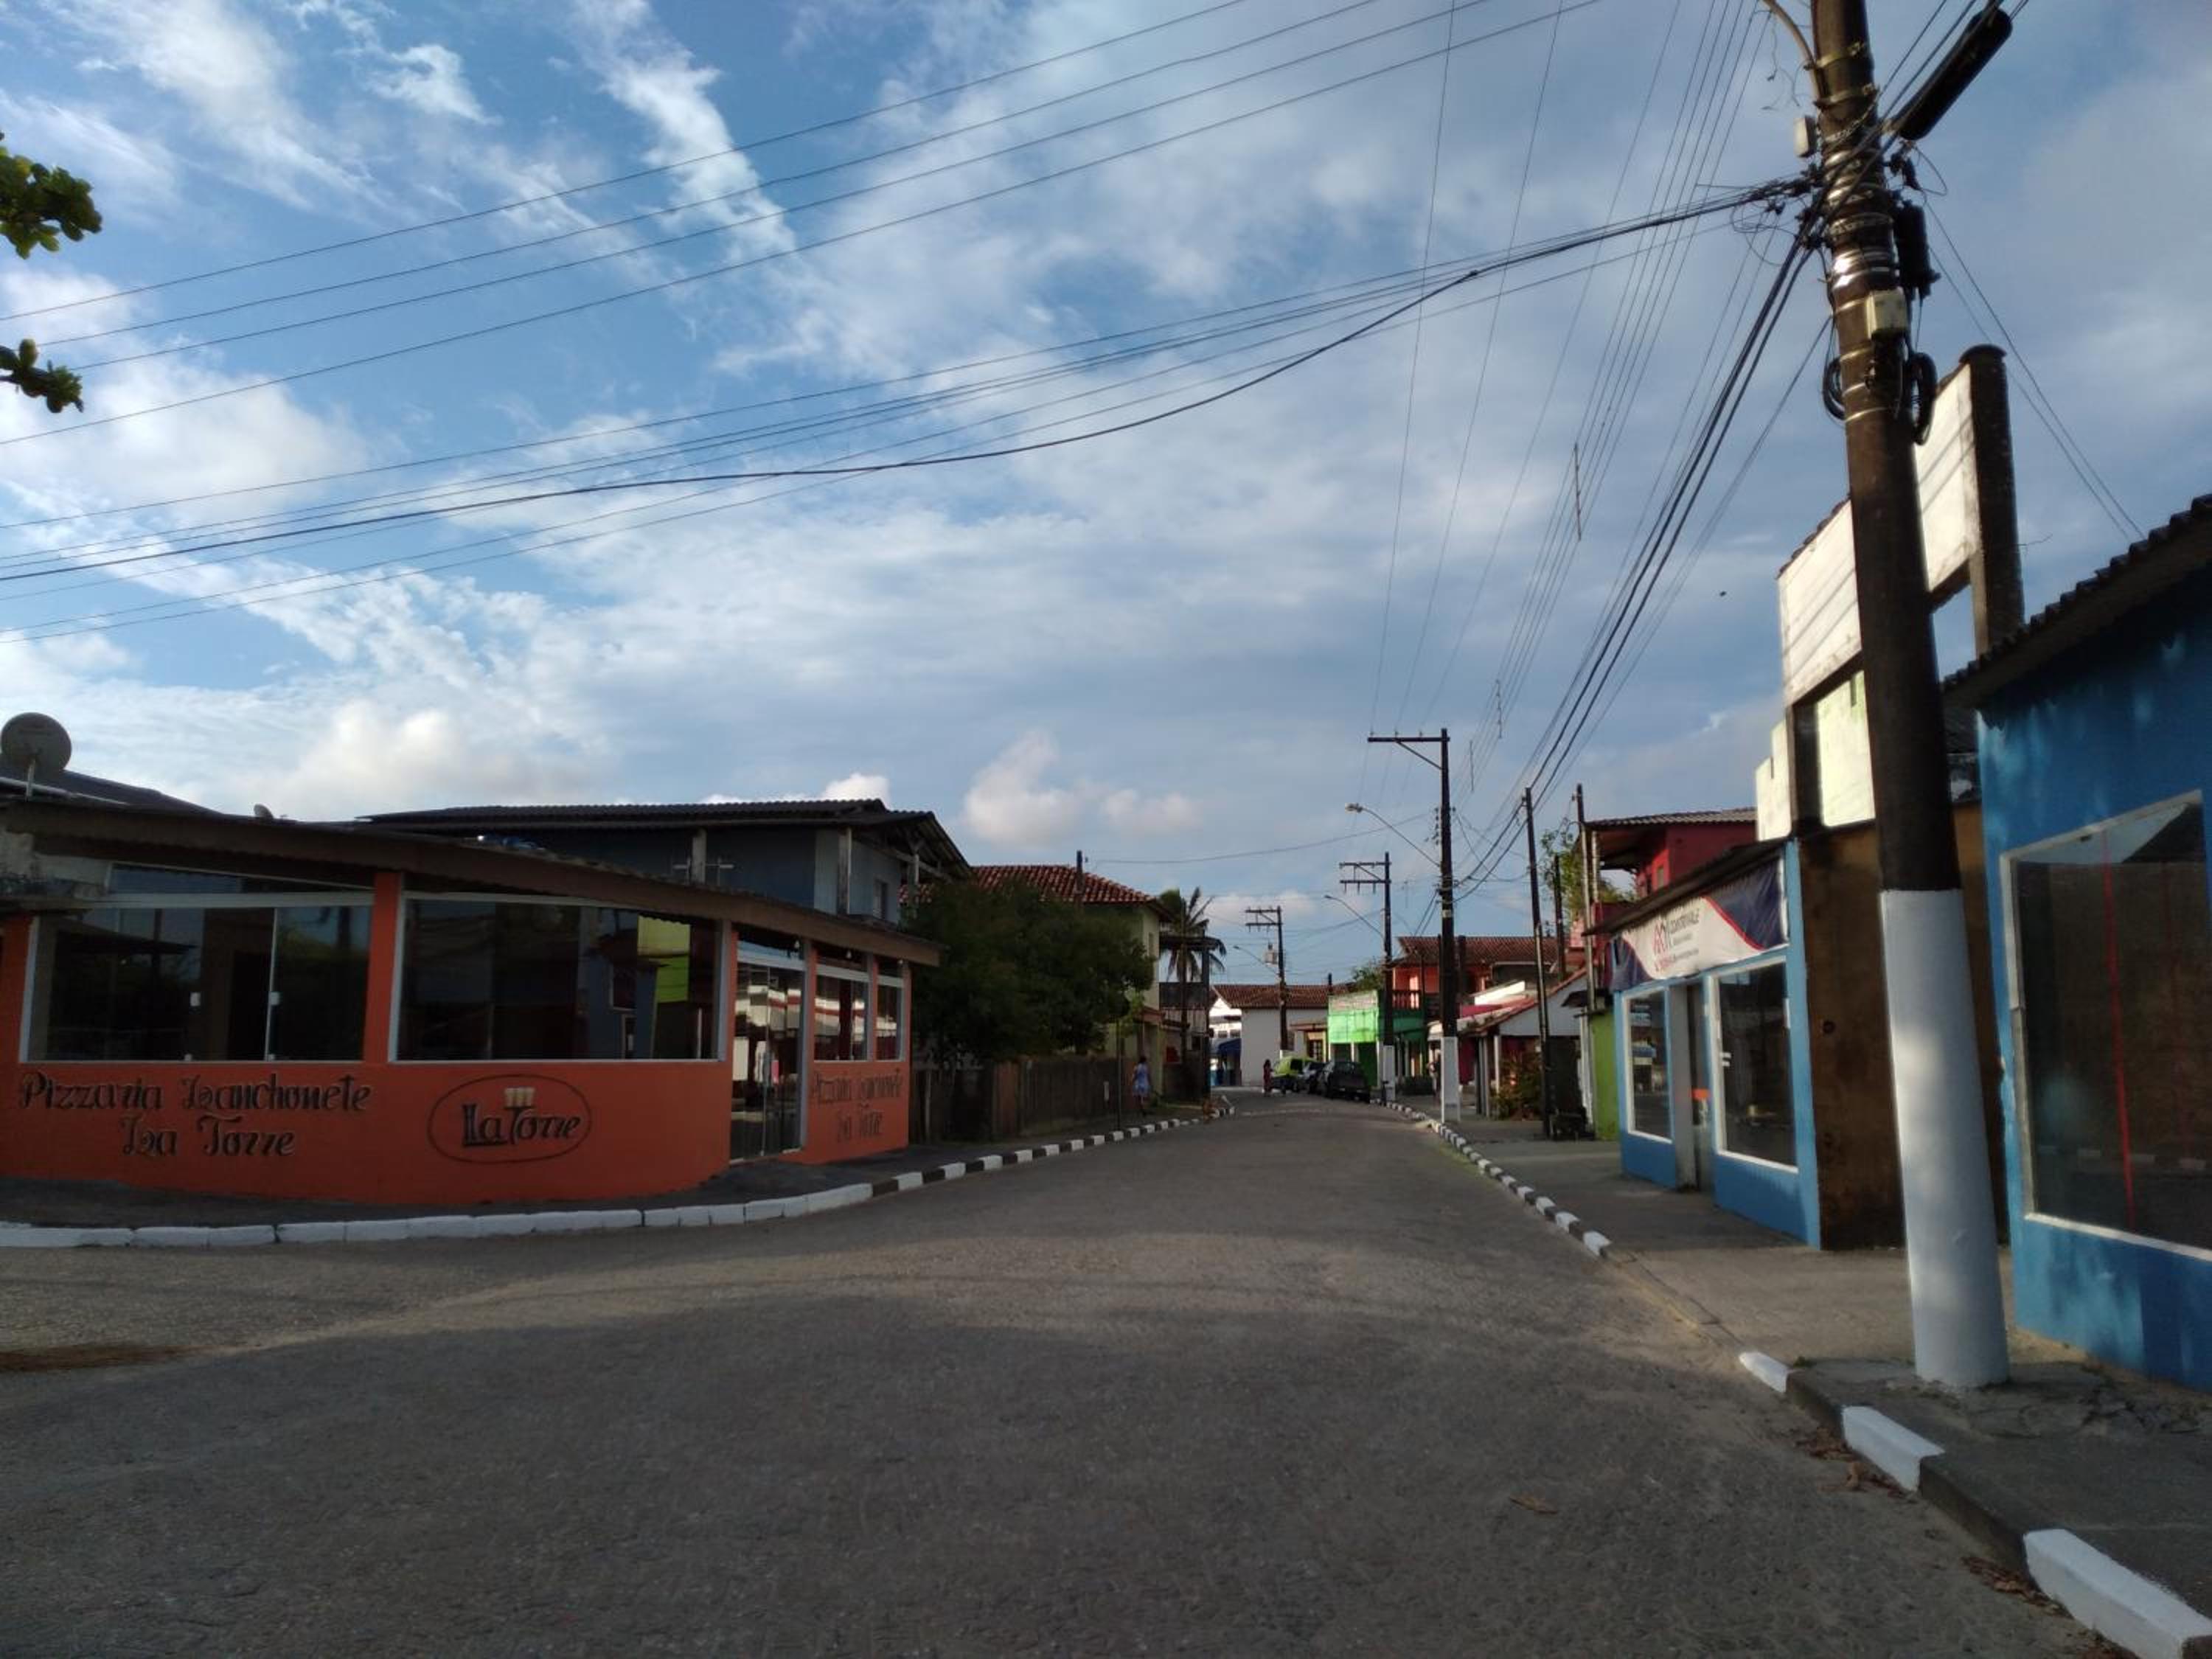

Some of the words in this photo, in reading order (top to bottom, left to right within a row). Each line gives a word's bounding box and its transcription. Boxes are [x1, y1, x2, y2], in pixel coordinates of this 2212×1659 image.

[20, 1071, 161, 1110] Pizzaria
[181, 1072, 372, 1111] Lanchonete
[119, 1114, 178, 1156] La
[198, 1114, 295, 1156] Torre
